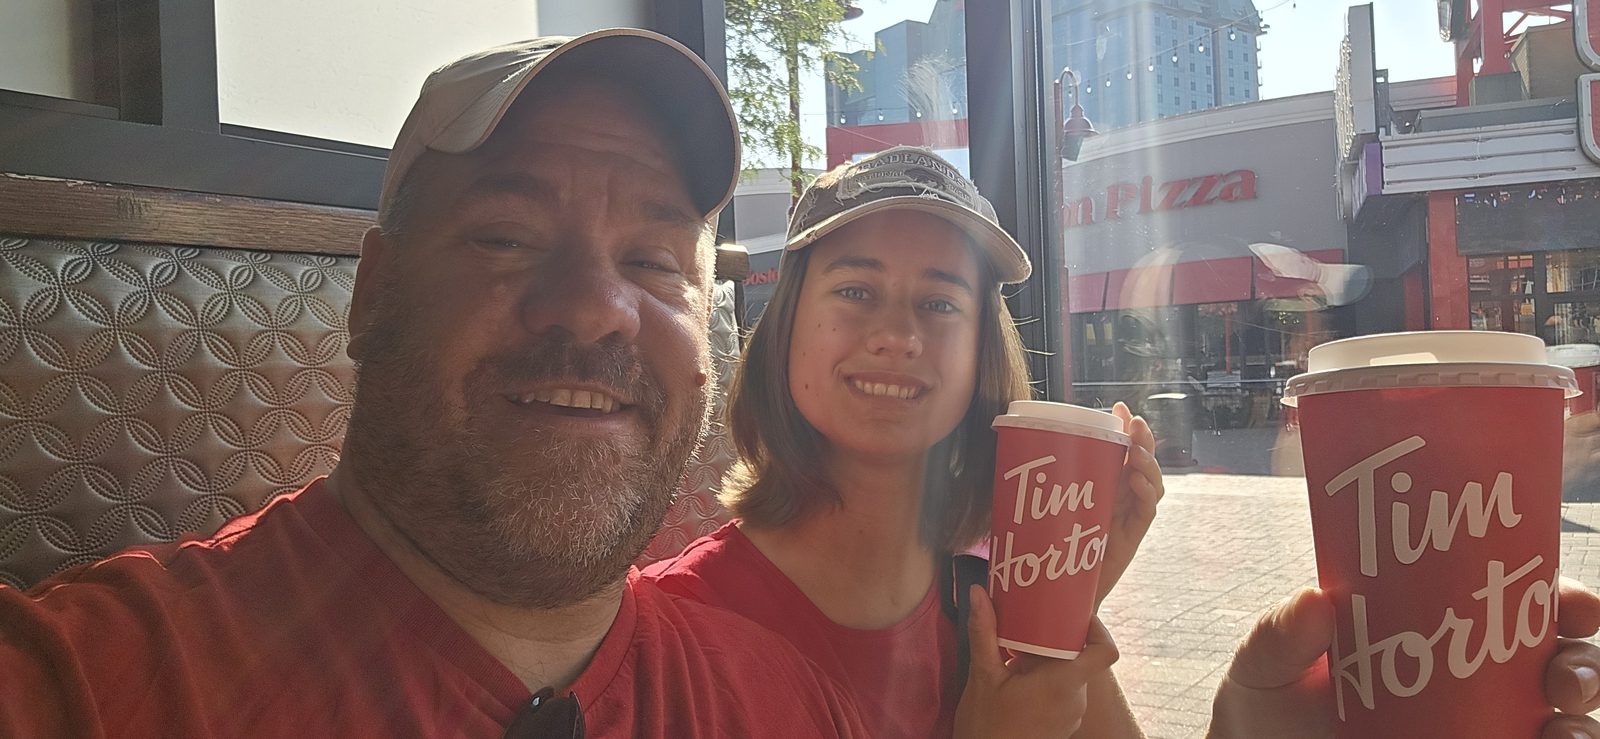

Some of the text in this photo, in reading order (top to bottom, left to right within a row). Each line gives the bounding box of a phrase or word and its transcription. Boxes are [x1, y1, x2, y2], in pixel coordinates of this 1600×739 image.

[859, 153, 967, 188] BADLANDS
[1105, 169, 1258, 220] Pizza
[1003, 455, 1095, 525] Tim
[1325, 435, 1523, 577] Tim
